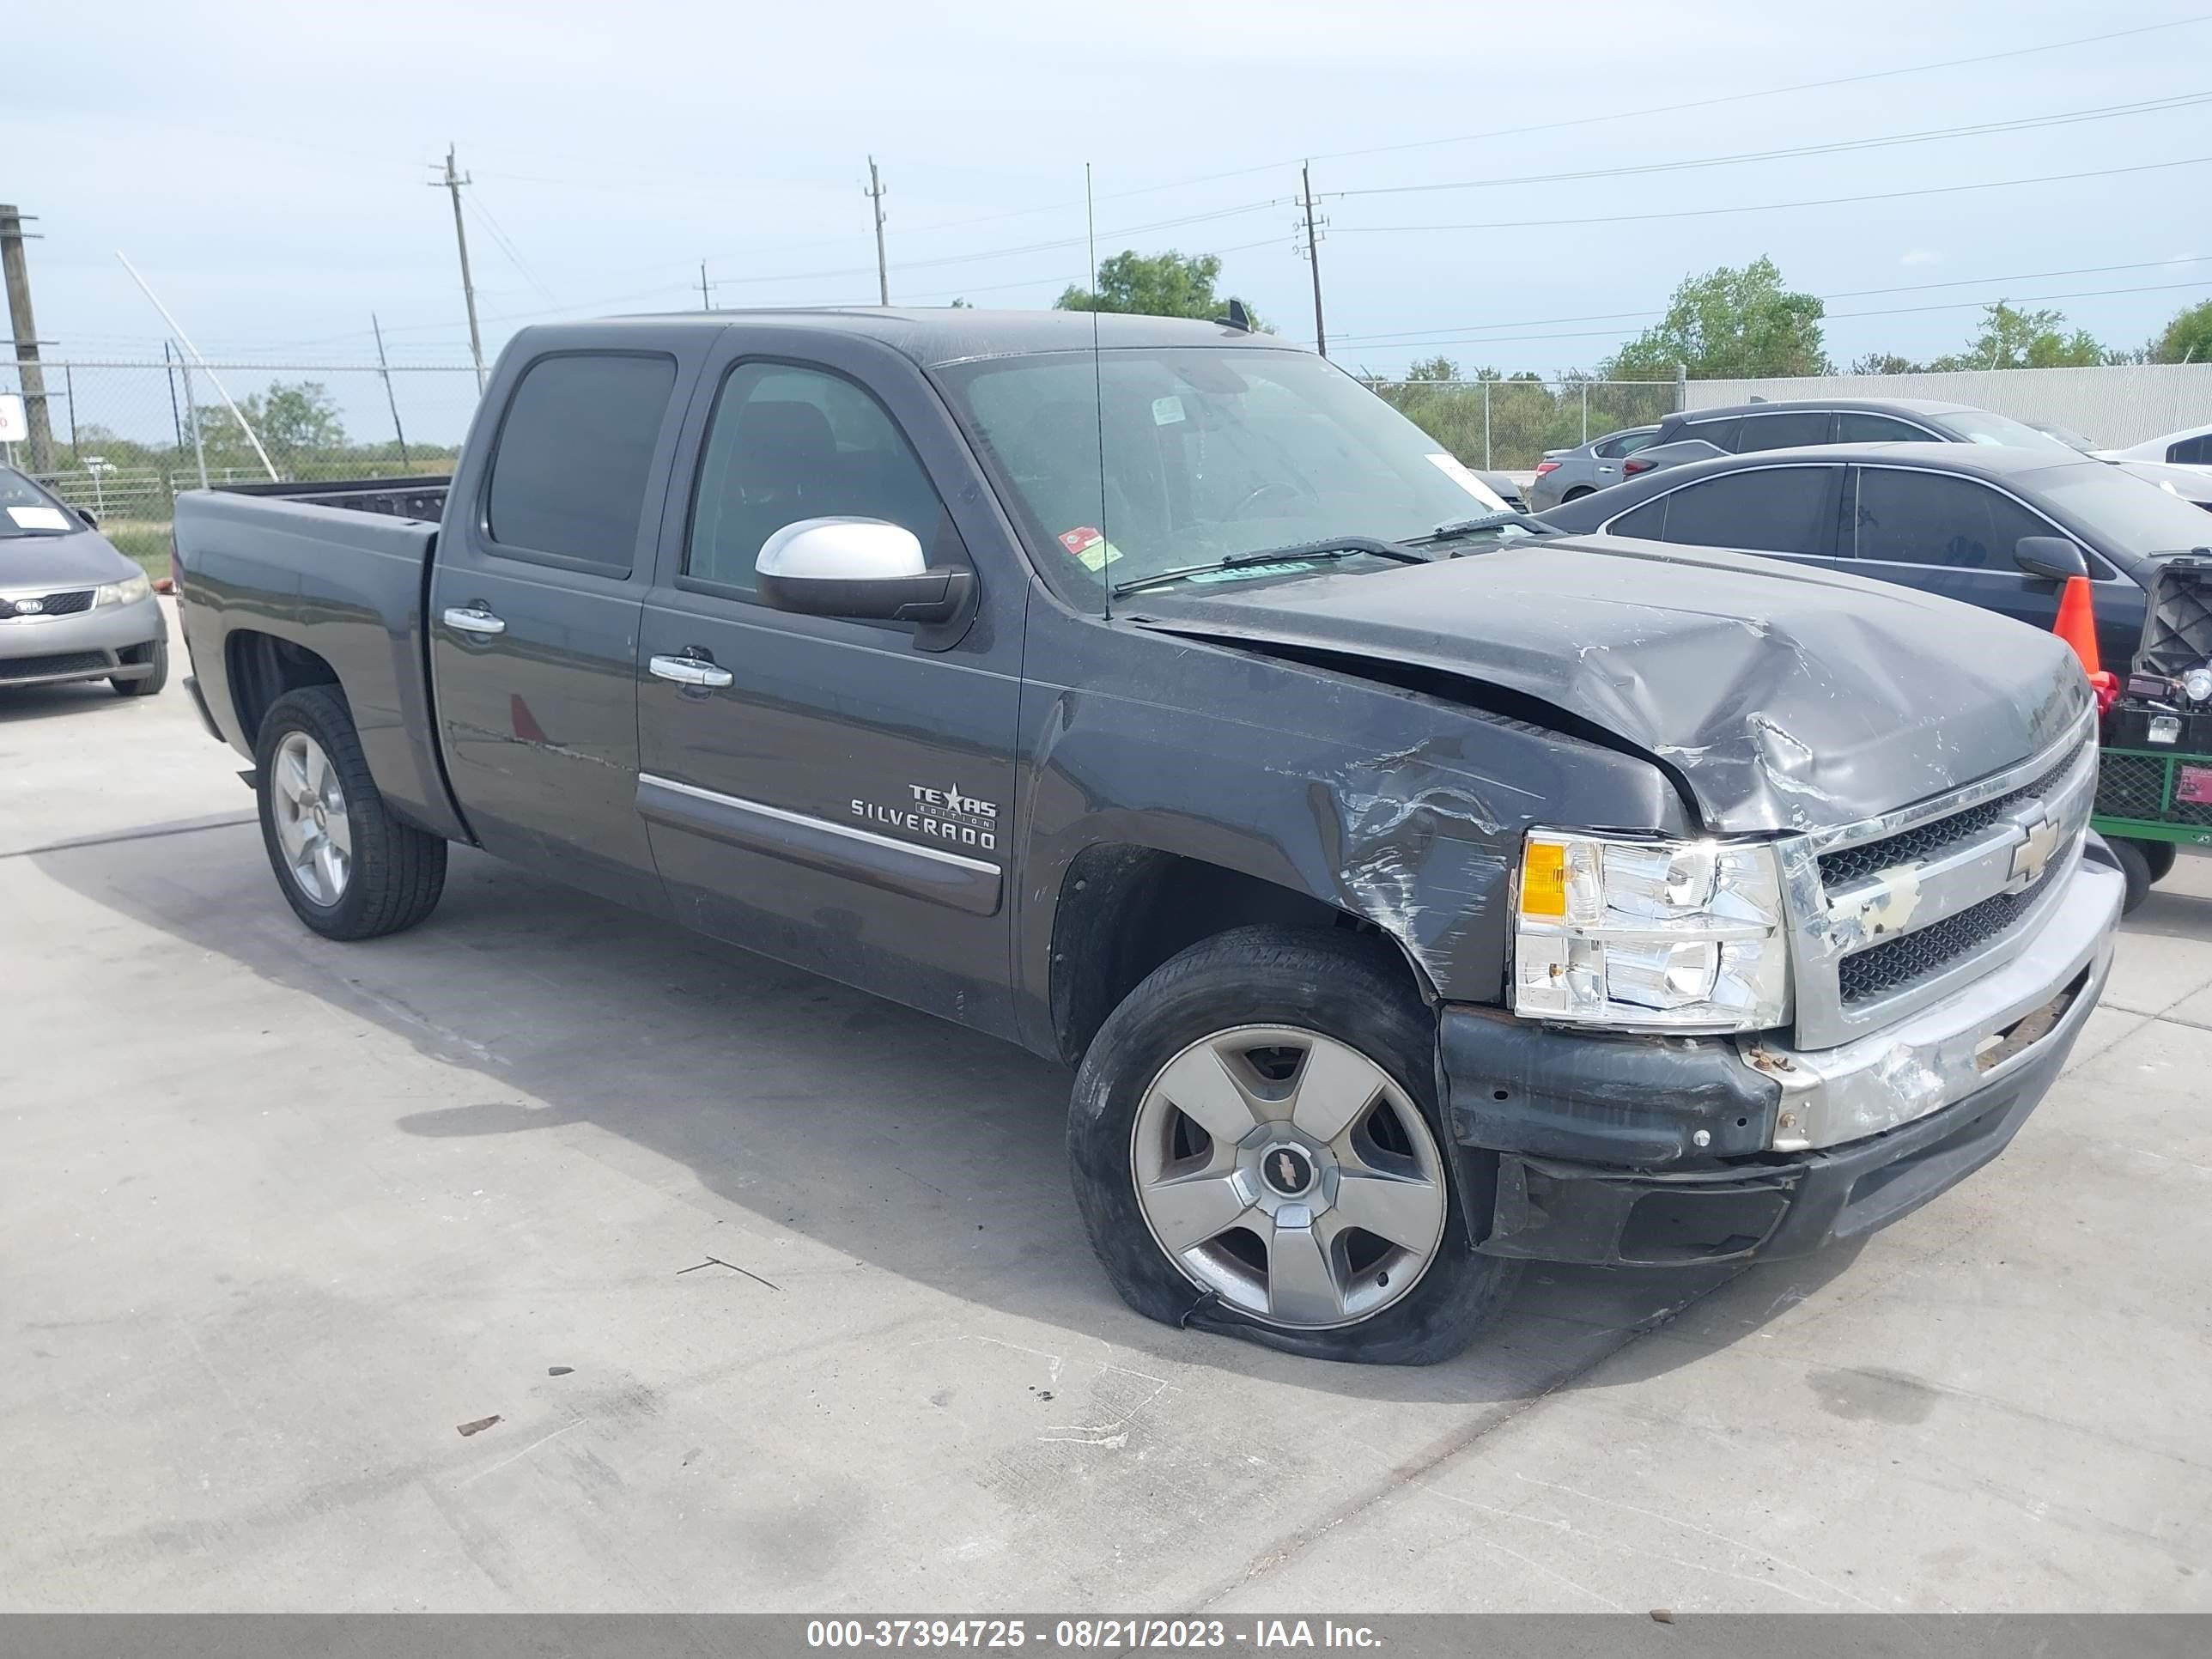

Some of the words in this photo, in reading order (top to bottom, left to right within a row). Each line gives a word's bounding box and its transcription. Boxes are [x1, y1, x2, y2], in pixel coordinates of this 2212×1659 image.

[908, 782, 997, 817] TEXAS
[919, 805, 991, 828] EDITION
[851, 799, 995, 850] SILVERADO
